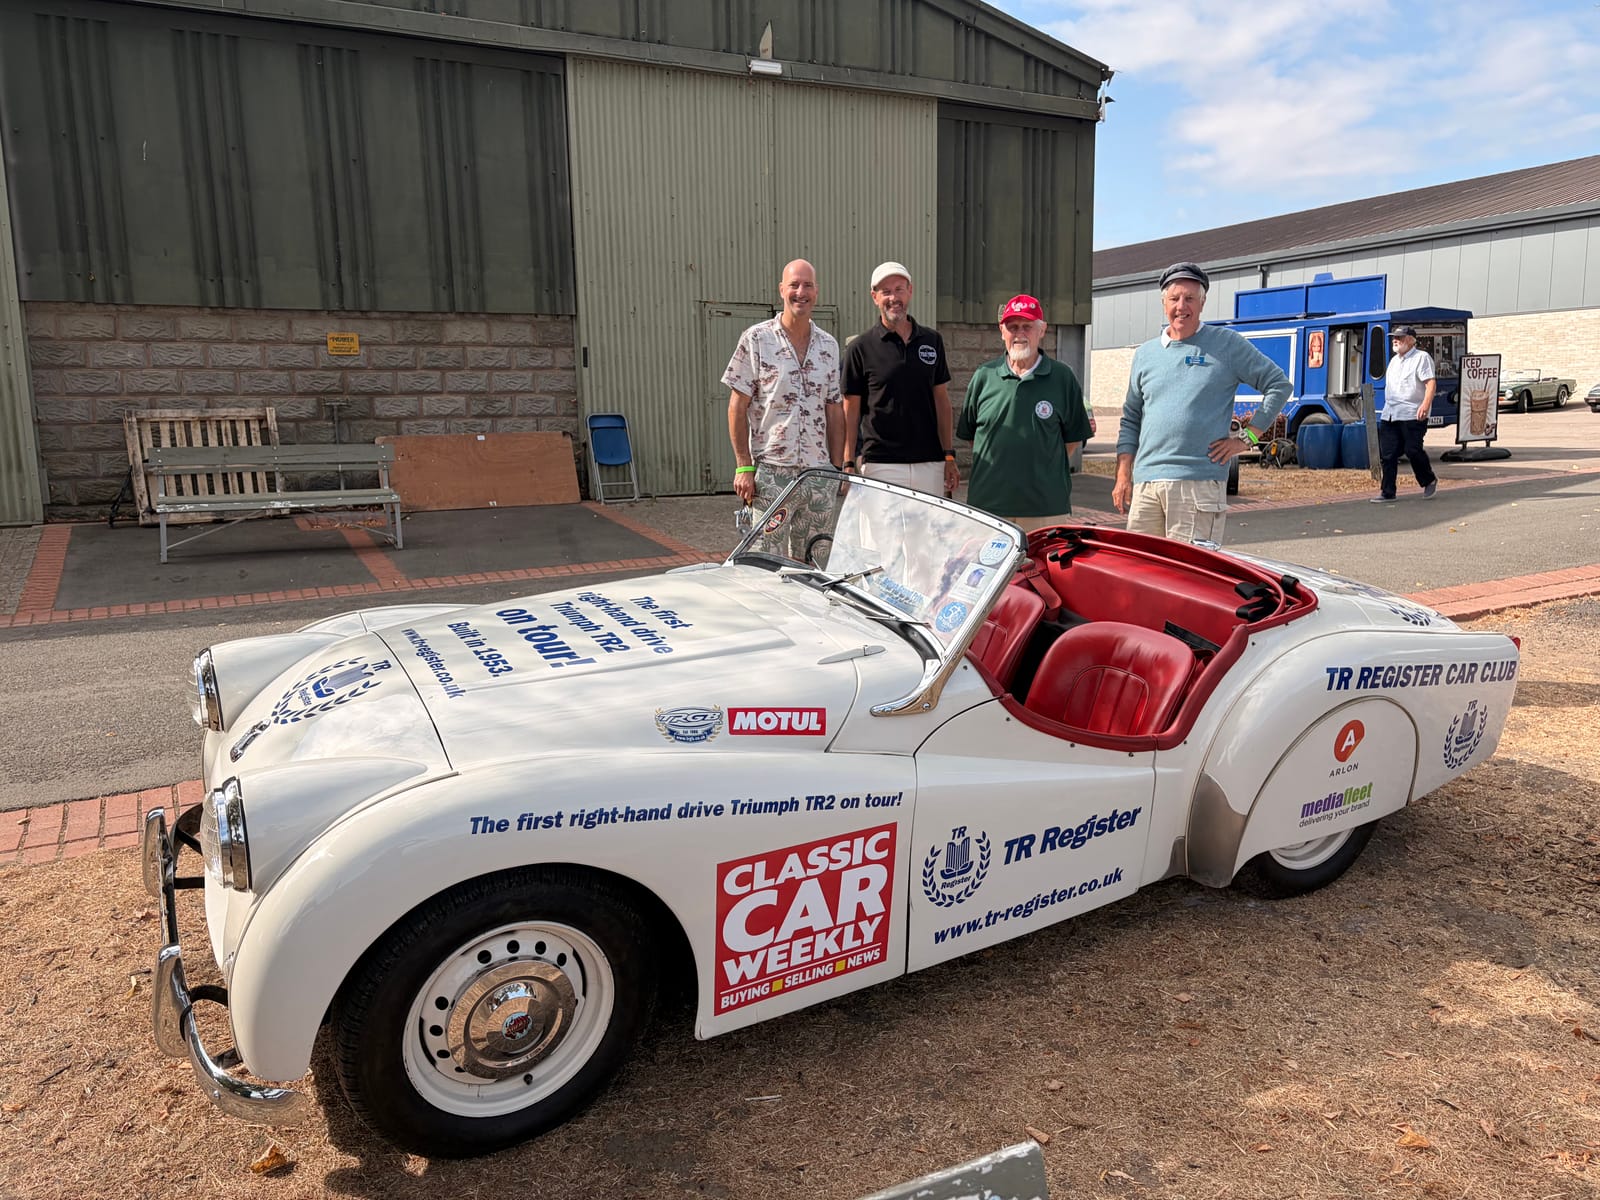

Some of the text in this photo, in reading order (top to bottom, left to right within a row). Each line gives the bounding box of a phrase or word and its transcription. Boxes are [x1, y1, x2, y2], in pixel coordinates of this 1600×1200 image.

[1463, 358, 1482, 369] ICED
[1467, 367, 1498, 380] COFFEE
[550, 601, 632, 653] Triumph TR2
[576, 591, 674, 654] right-hand drive
[629, 596, 693, 630] The first
[447, 621, 513, 677] Built in 1953.
[496, 608, 597, 668] on tour!
[371, 659, 392, 671] TR
[401, 628, 466, 699] www.tr-register.co.uk
[1325, 660, 1517, 691] TR REGISTER CAR CLUB
[657, 710, 723, 725] TRGB
[732, 711, 822, 731] MOTUL
[1467, 699, 1478, 711] TR
[1340, 729, 1356, 752] A
[1329, 762, 1359, 778] ARLON
[469, 791, 903, 835] The first right-hand drive Triumph TR2 on tour!
[1299, 799, 1370, 828] delivering your brand
[1300, 782, 1373, 818] mediafleet
[951, 825, 967, 841] TR
[1003, 806, 1142, 866] TR Register
[723, 830, 890, 896] CLASSIC
[940, 875, 972, 890] Register
[722, 863, 888, 953] CAR
[934, 867, 1123, 945] www.tr-register.co.uk
[722, 915, 885, 986] WEEKLY
[720, 948, 880, 1009] BUYING SELLING NEWS
